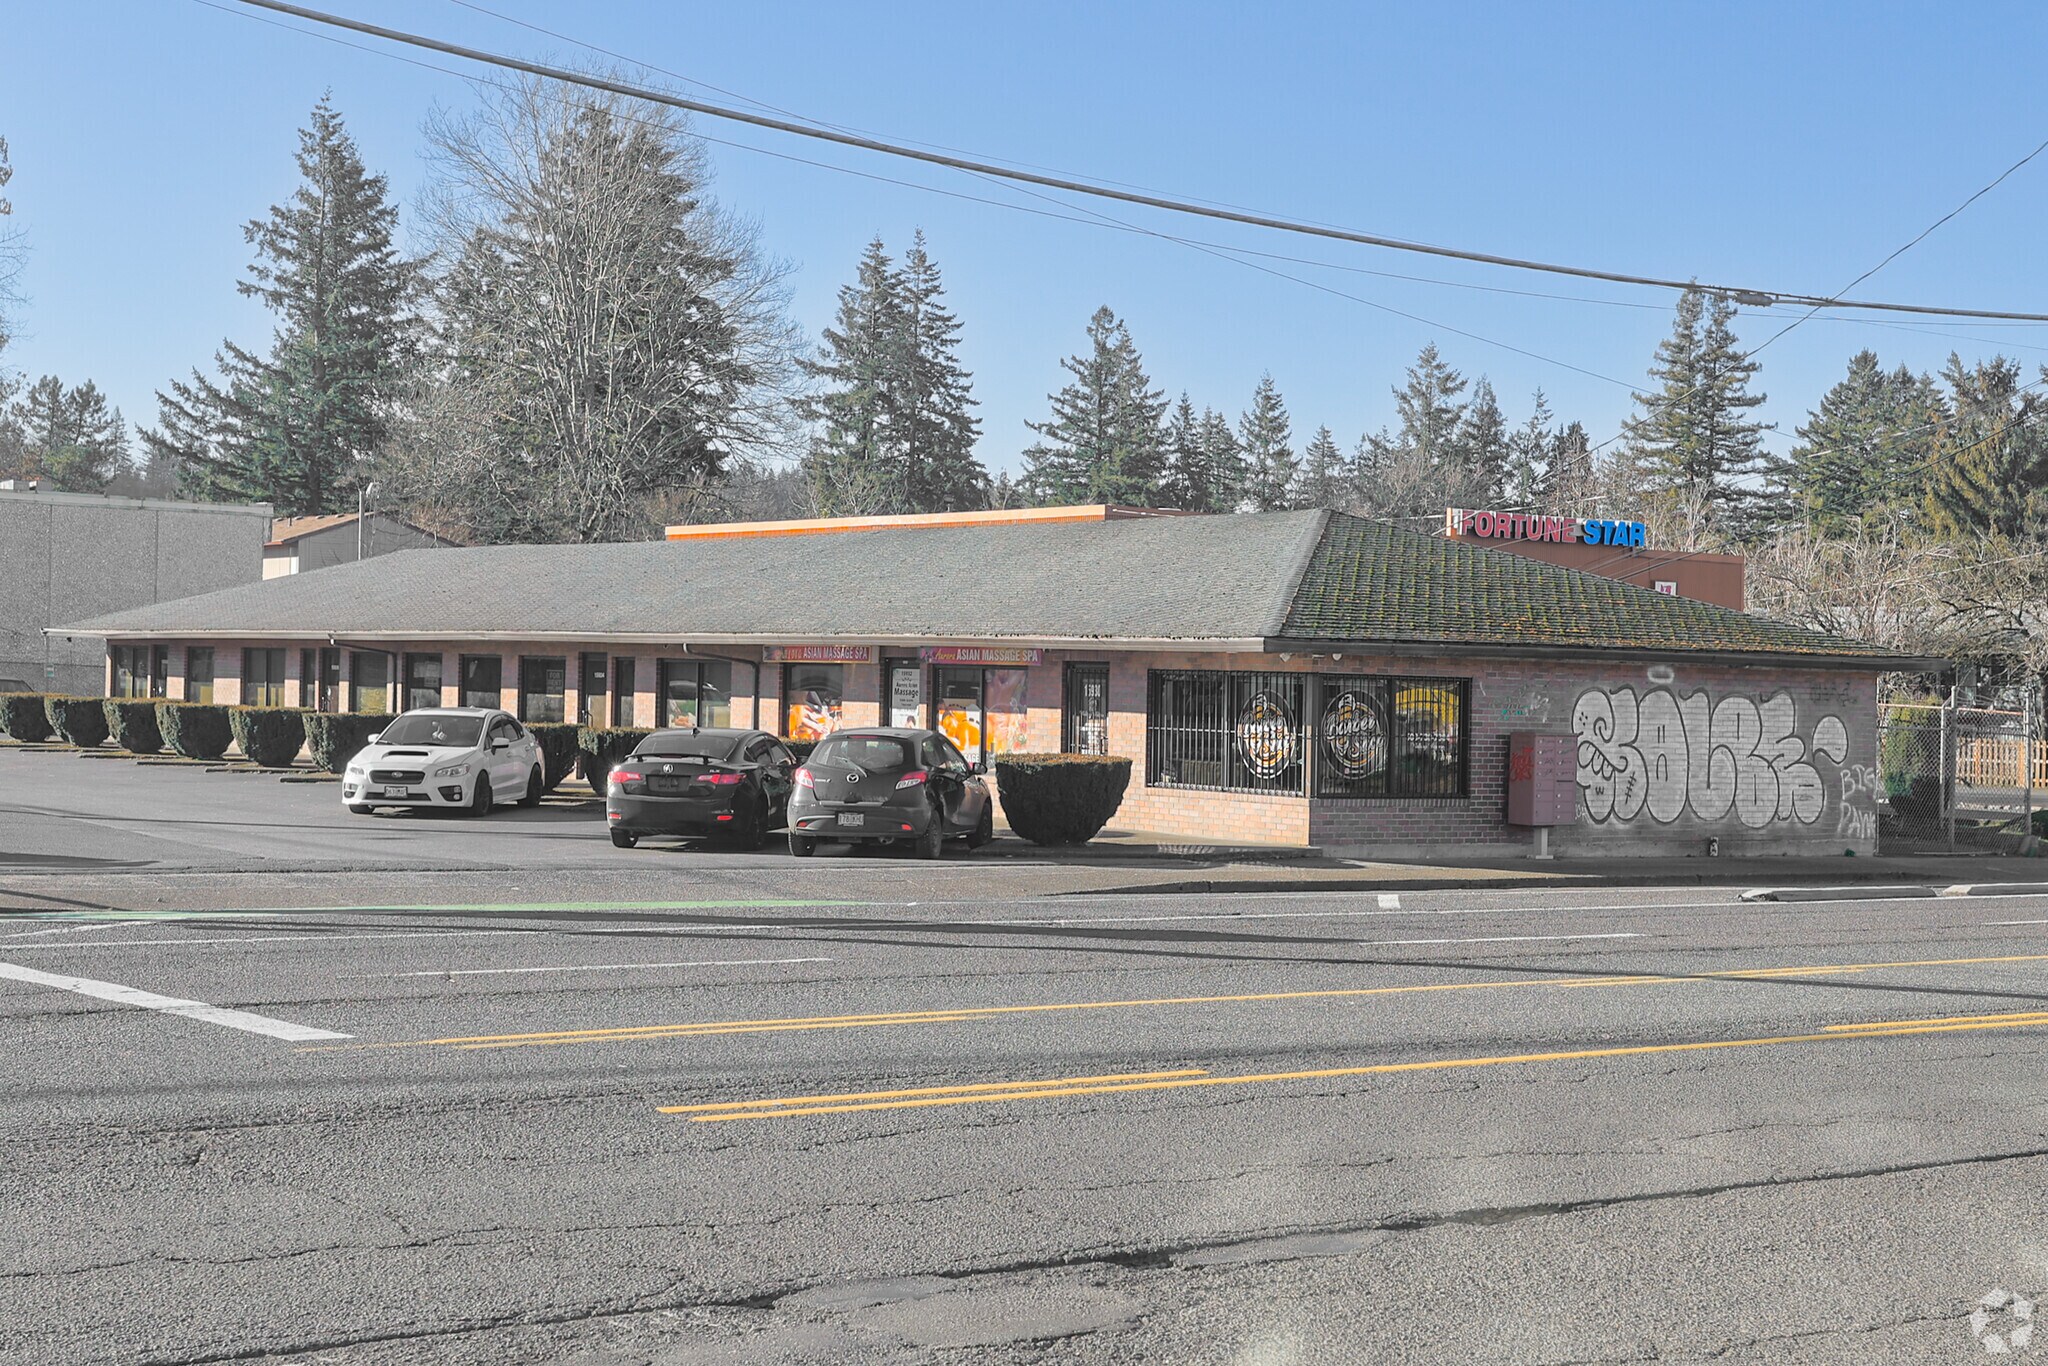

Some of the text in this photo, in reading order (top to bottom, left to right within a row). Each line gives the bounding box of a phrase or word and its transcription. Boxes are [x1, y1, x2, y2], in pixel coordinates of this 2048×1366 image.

[1463, 510, 1646, 547] FORTUNE STAR
[804, 647, 821, 659] ASIAN
[824, 647, 853, 659] MASSAGE
[855, 648, 867, 659] SPA
[957, 649, 980, 660] ASIAN
[982, 649, 1020, 661] MASSAGE
[1022, 650, 1038, 662] SPA
[894, 688, 919, 699] Massage
[1841, 764, 1875, 800] BIG
